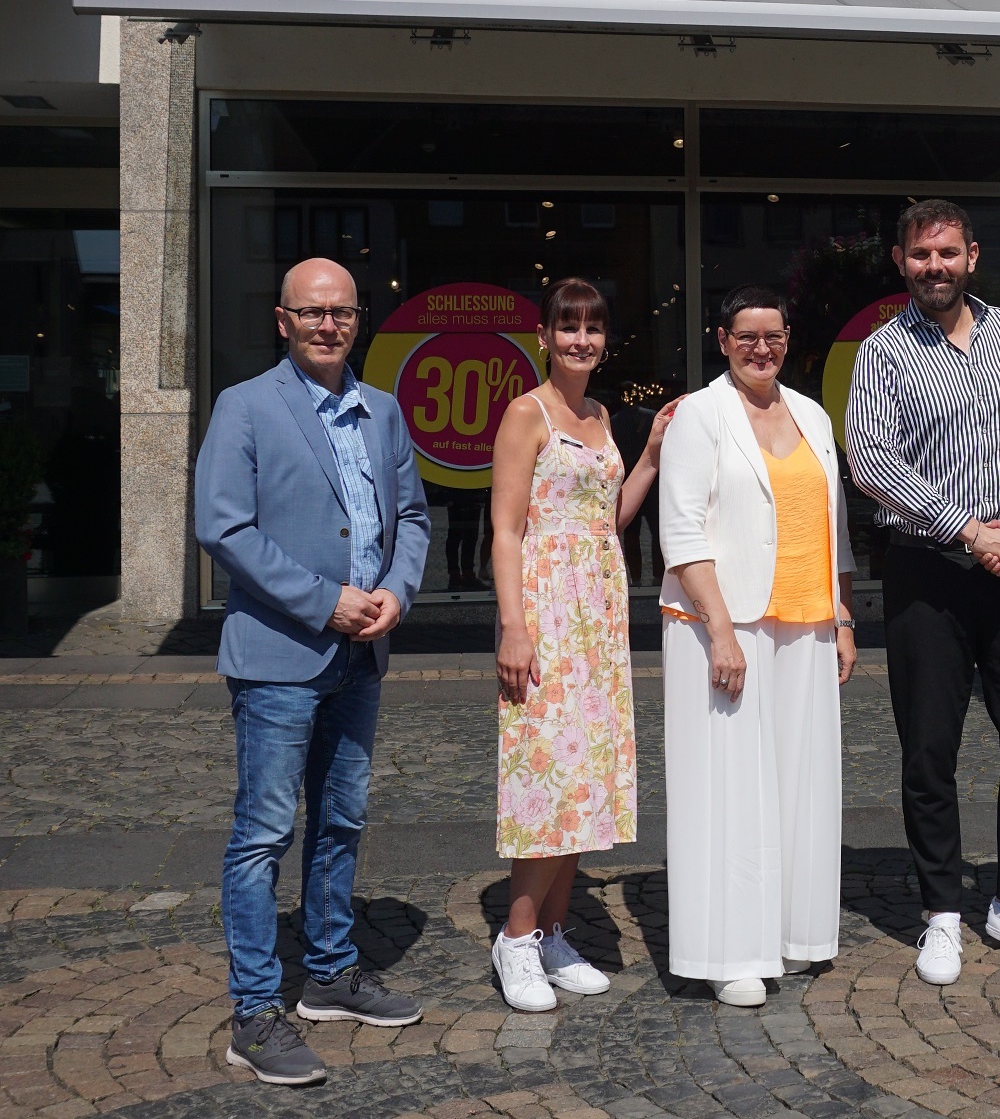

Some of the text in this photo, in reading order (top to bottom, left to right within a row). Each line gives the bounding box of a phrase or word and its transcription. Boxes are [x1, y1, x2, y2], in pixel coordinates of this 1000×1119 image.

[427, 295, 515, 312] SCHLIESSUNG
[418, 312, 522, 325] alles muss raus
[412, 356, 523, 436] 30%
[432, 440, 449, 449] auf
[452, 440, 471, 451] fast
